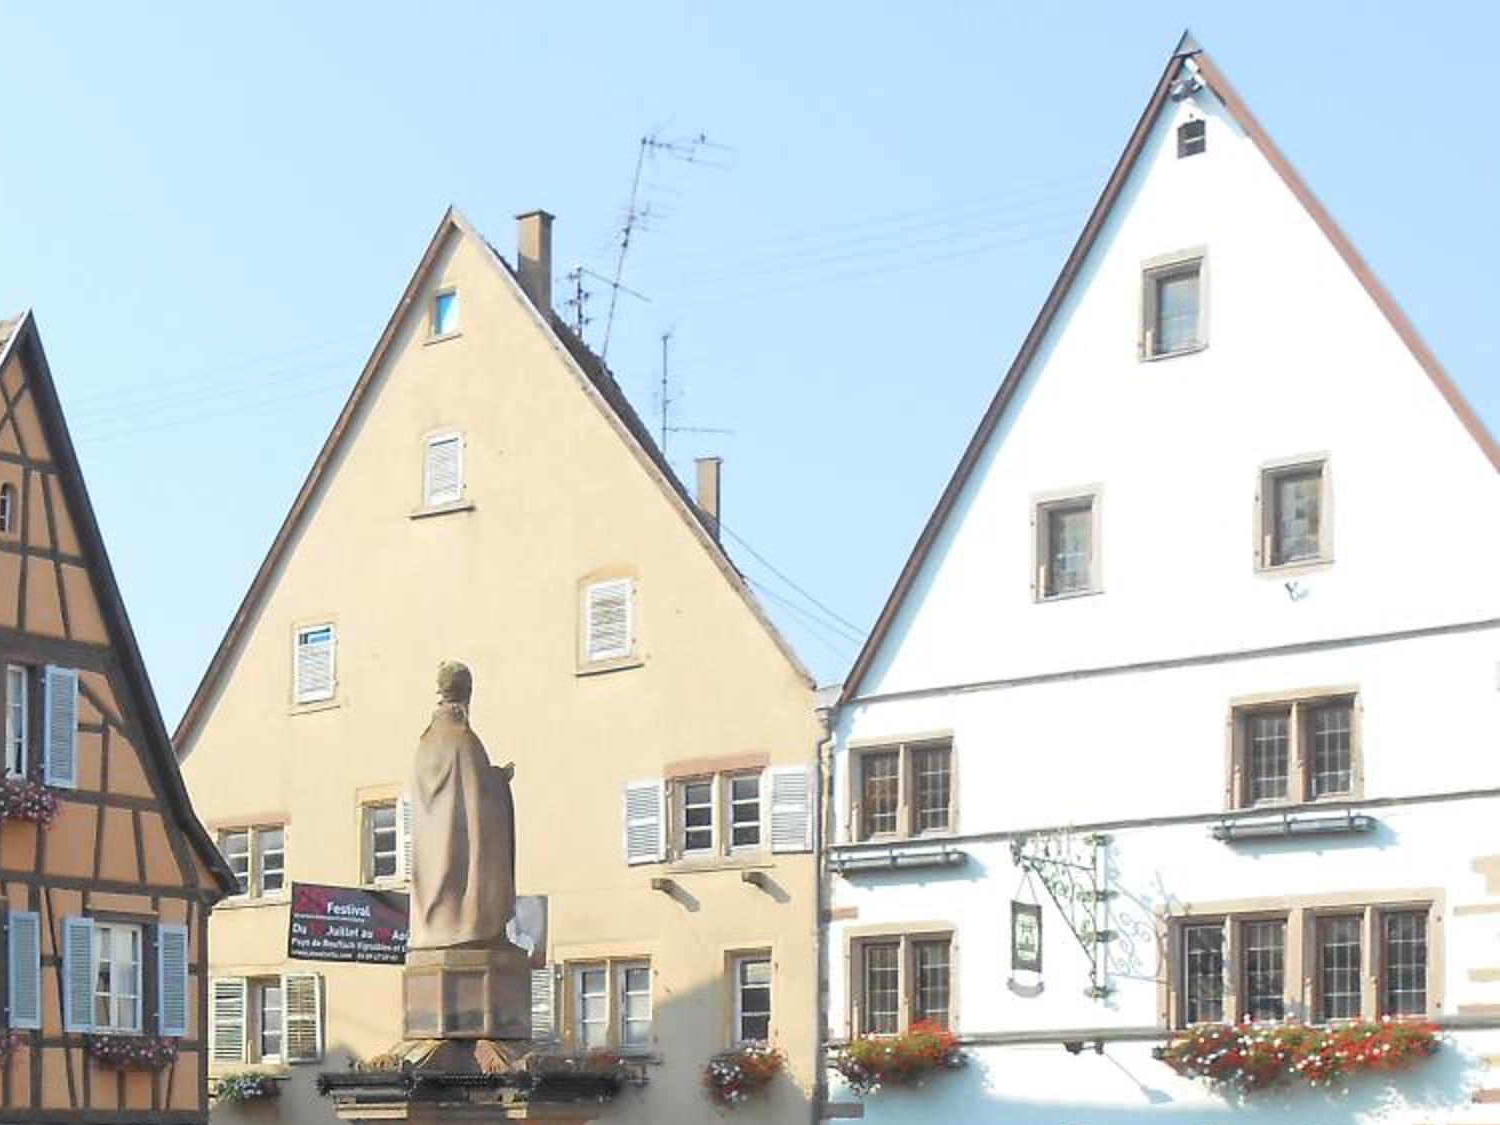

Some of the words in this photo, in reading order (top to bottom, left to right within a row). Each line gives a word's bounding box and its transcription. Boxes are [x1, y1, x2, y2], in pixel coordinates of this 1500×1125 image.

[327, 902, 371, 917] Festival
[292, 923, 307, 935] Du
[326, 925, 359, 938] Juillet
[360, 929, 373, 939] au
